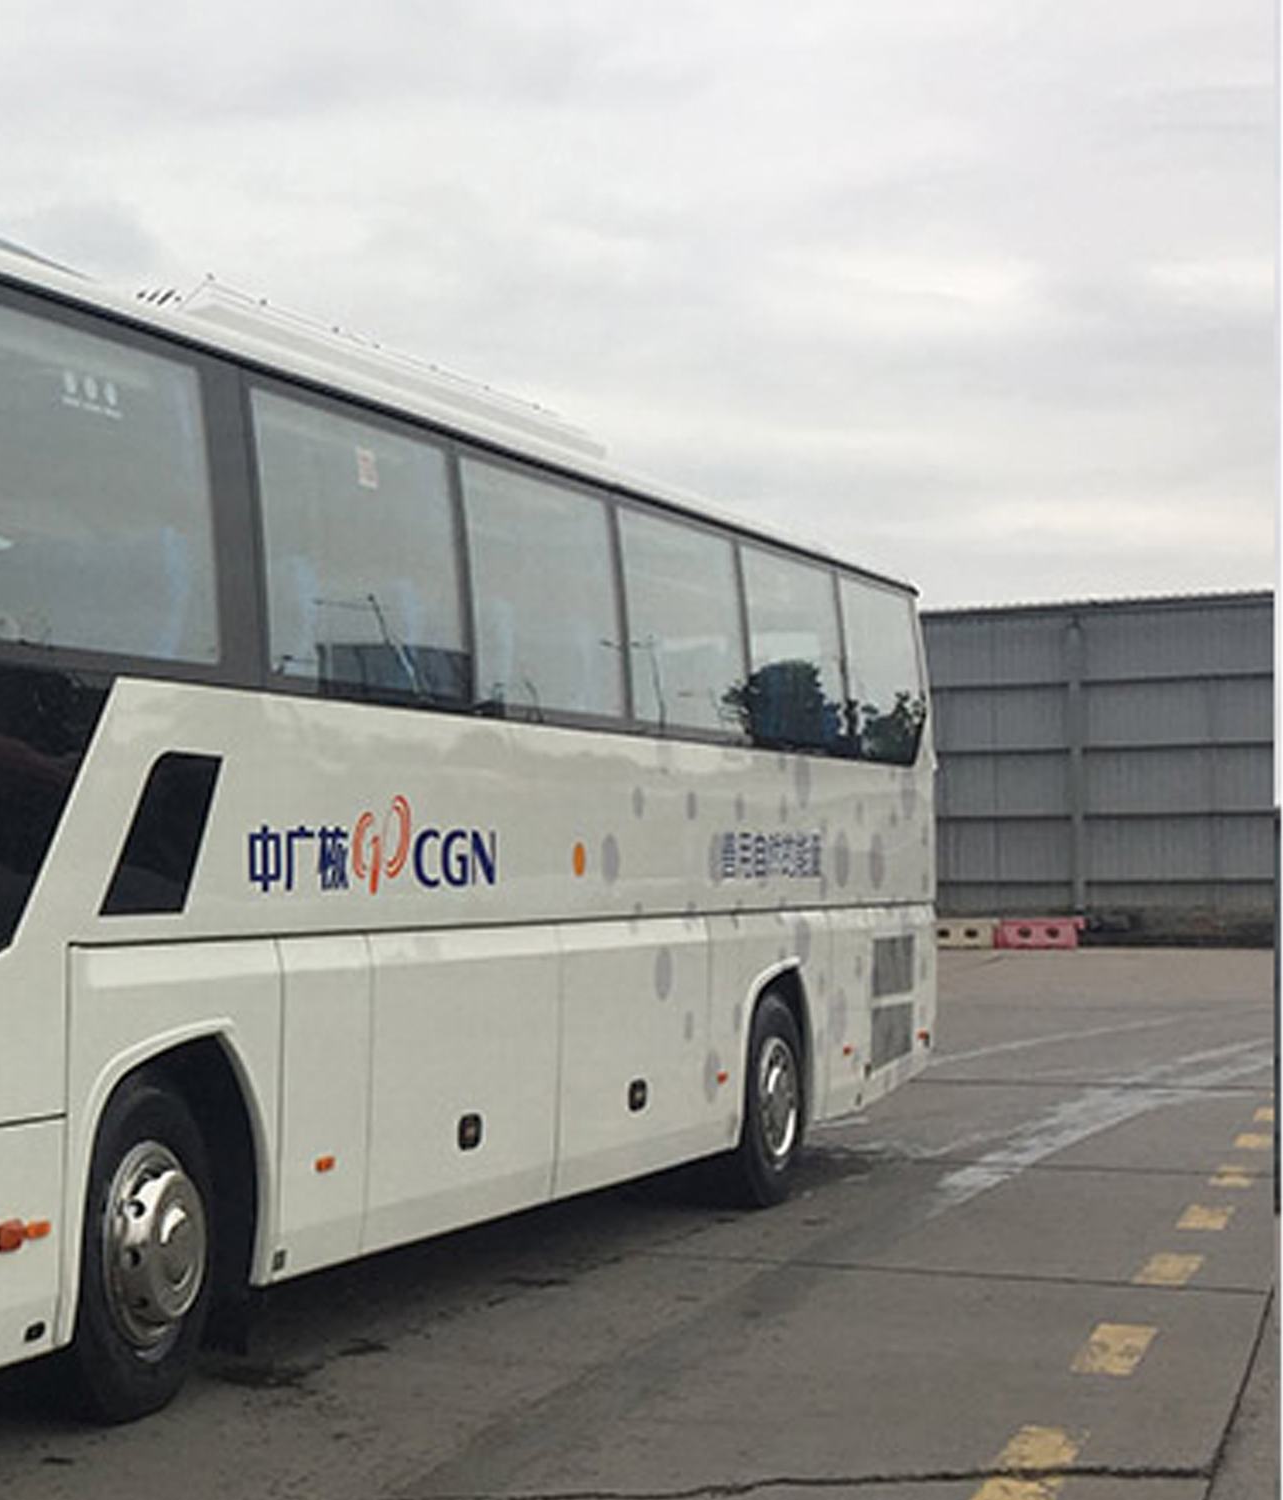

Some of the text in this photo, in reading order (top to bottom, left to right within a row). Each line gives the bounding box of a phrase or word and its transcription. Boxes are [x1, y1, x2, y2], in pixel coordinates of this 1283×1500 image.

[248, 825, 497, 892] 中广核 CGN
